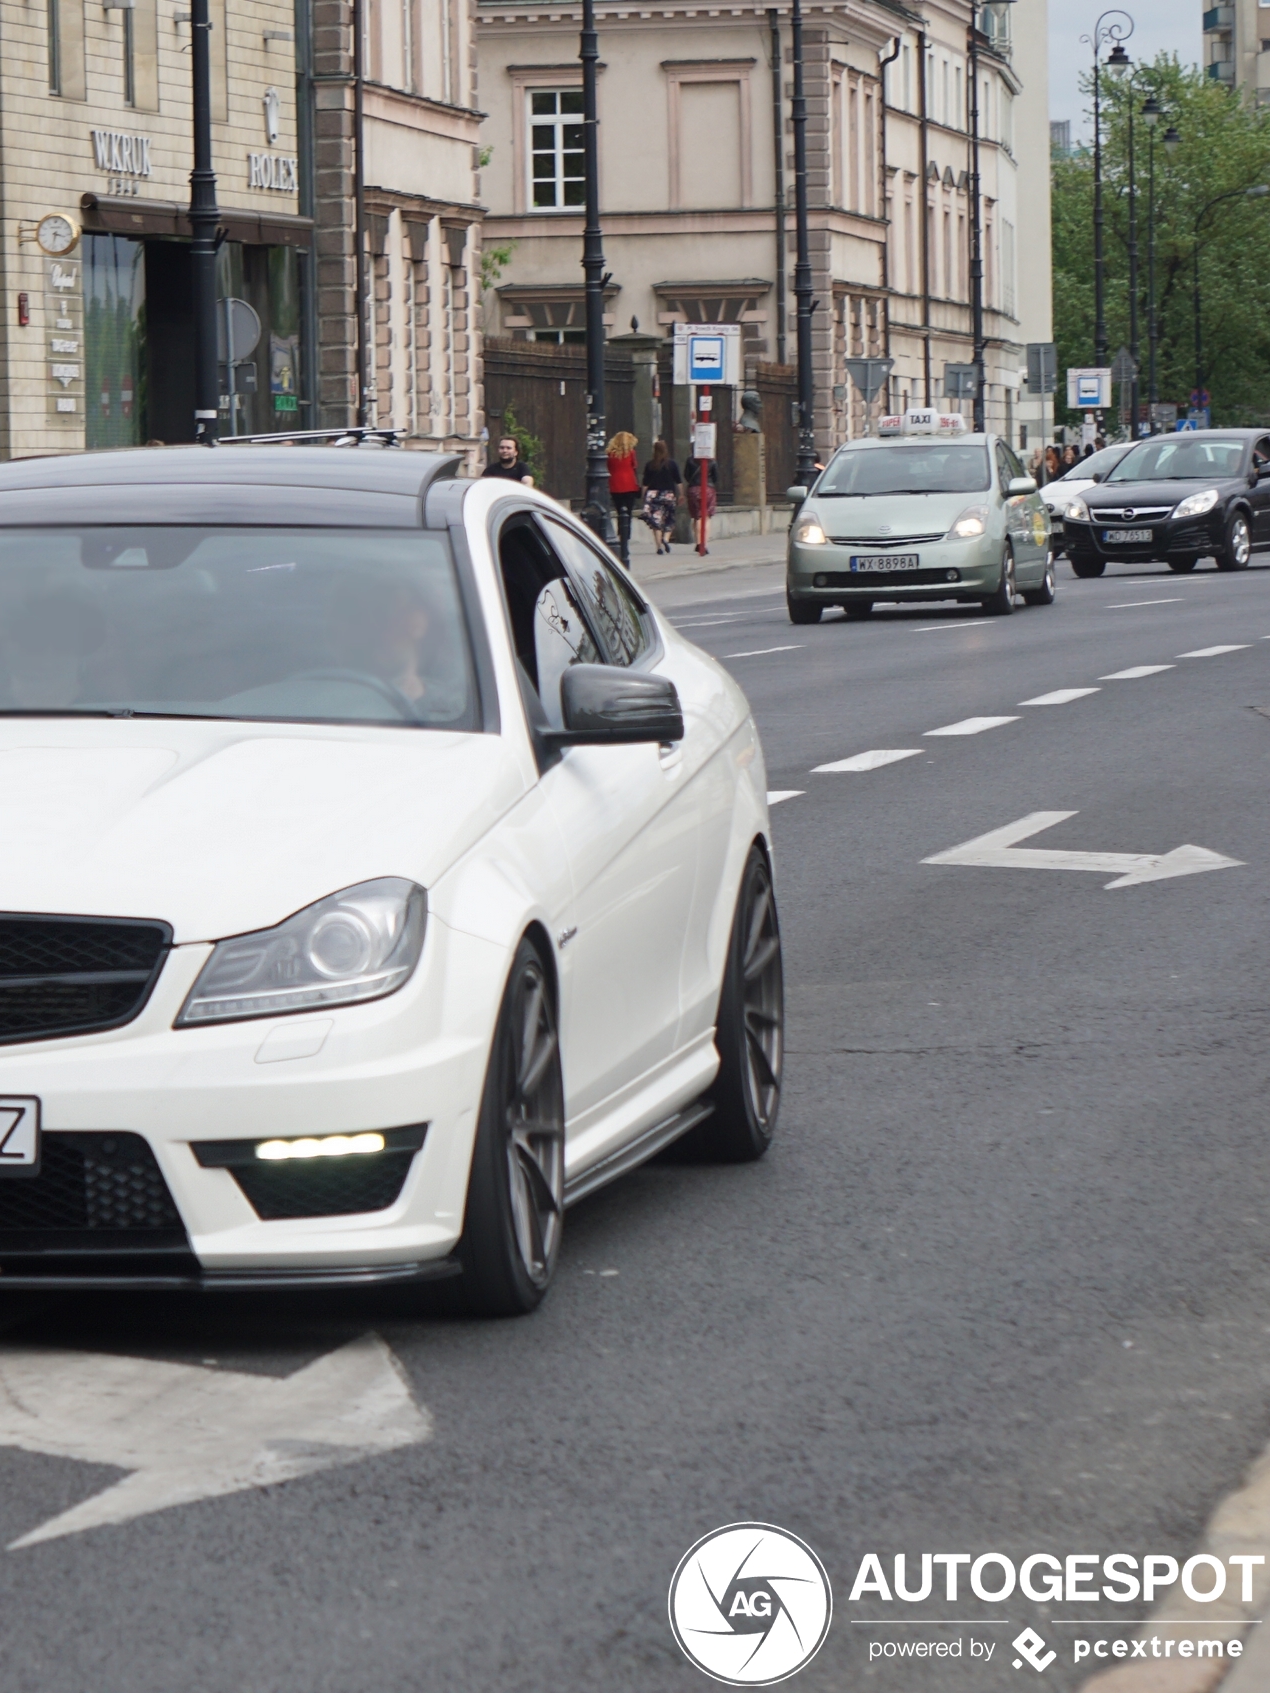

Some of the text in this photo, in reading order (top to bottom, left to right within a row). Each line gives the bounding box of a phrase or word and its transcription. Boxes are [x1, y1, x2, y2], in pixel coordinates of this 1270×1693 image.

[248, 153, 298, 190] ROLEX
[909, 414, 931, 424] TAXI
[858, 557, 915, 570] WX 8898A
